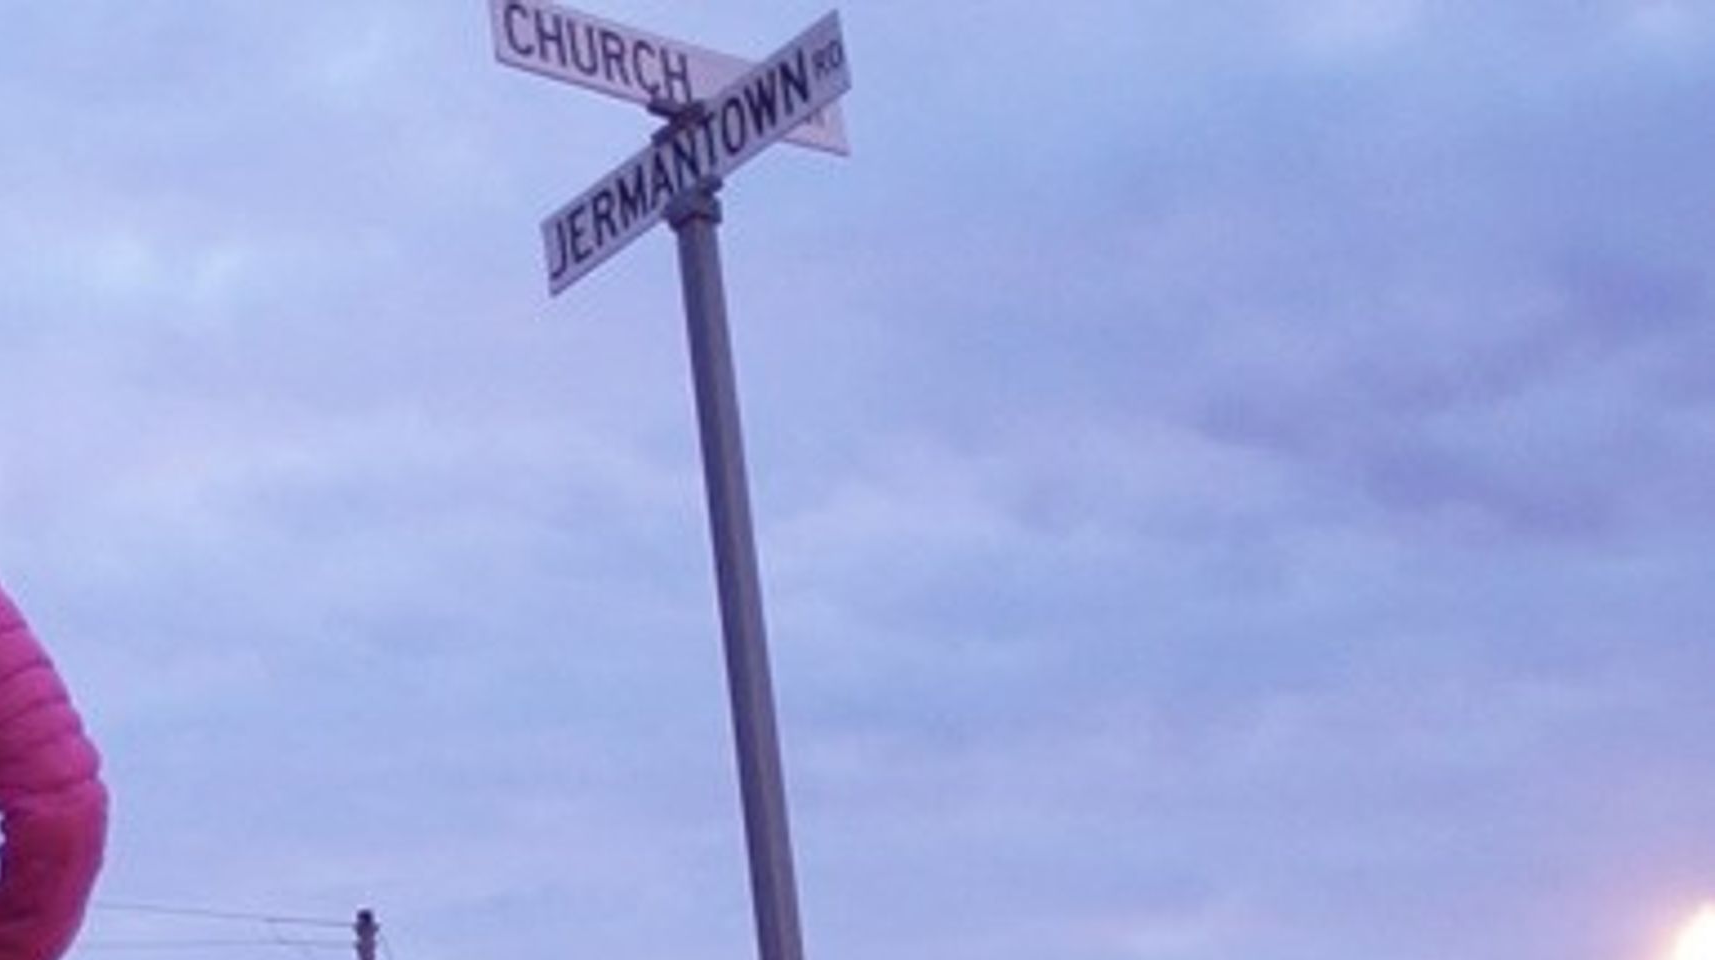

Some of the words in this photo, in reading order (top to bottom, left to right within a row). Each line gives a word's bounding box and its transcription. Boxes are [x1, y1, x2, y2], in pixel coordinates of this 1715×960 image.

[503, 3, 692, 104] CHURCH
[549, 48, 810, 281] JERMANTOWN
[812, 40, 845, 81] RD
